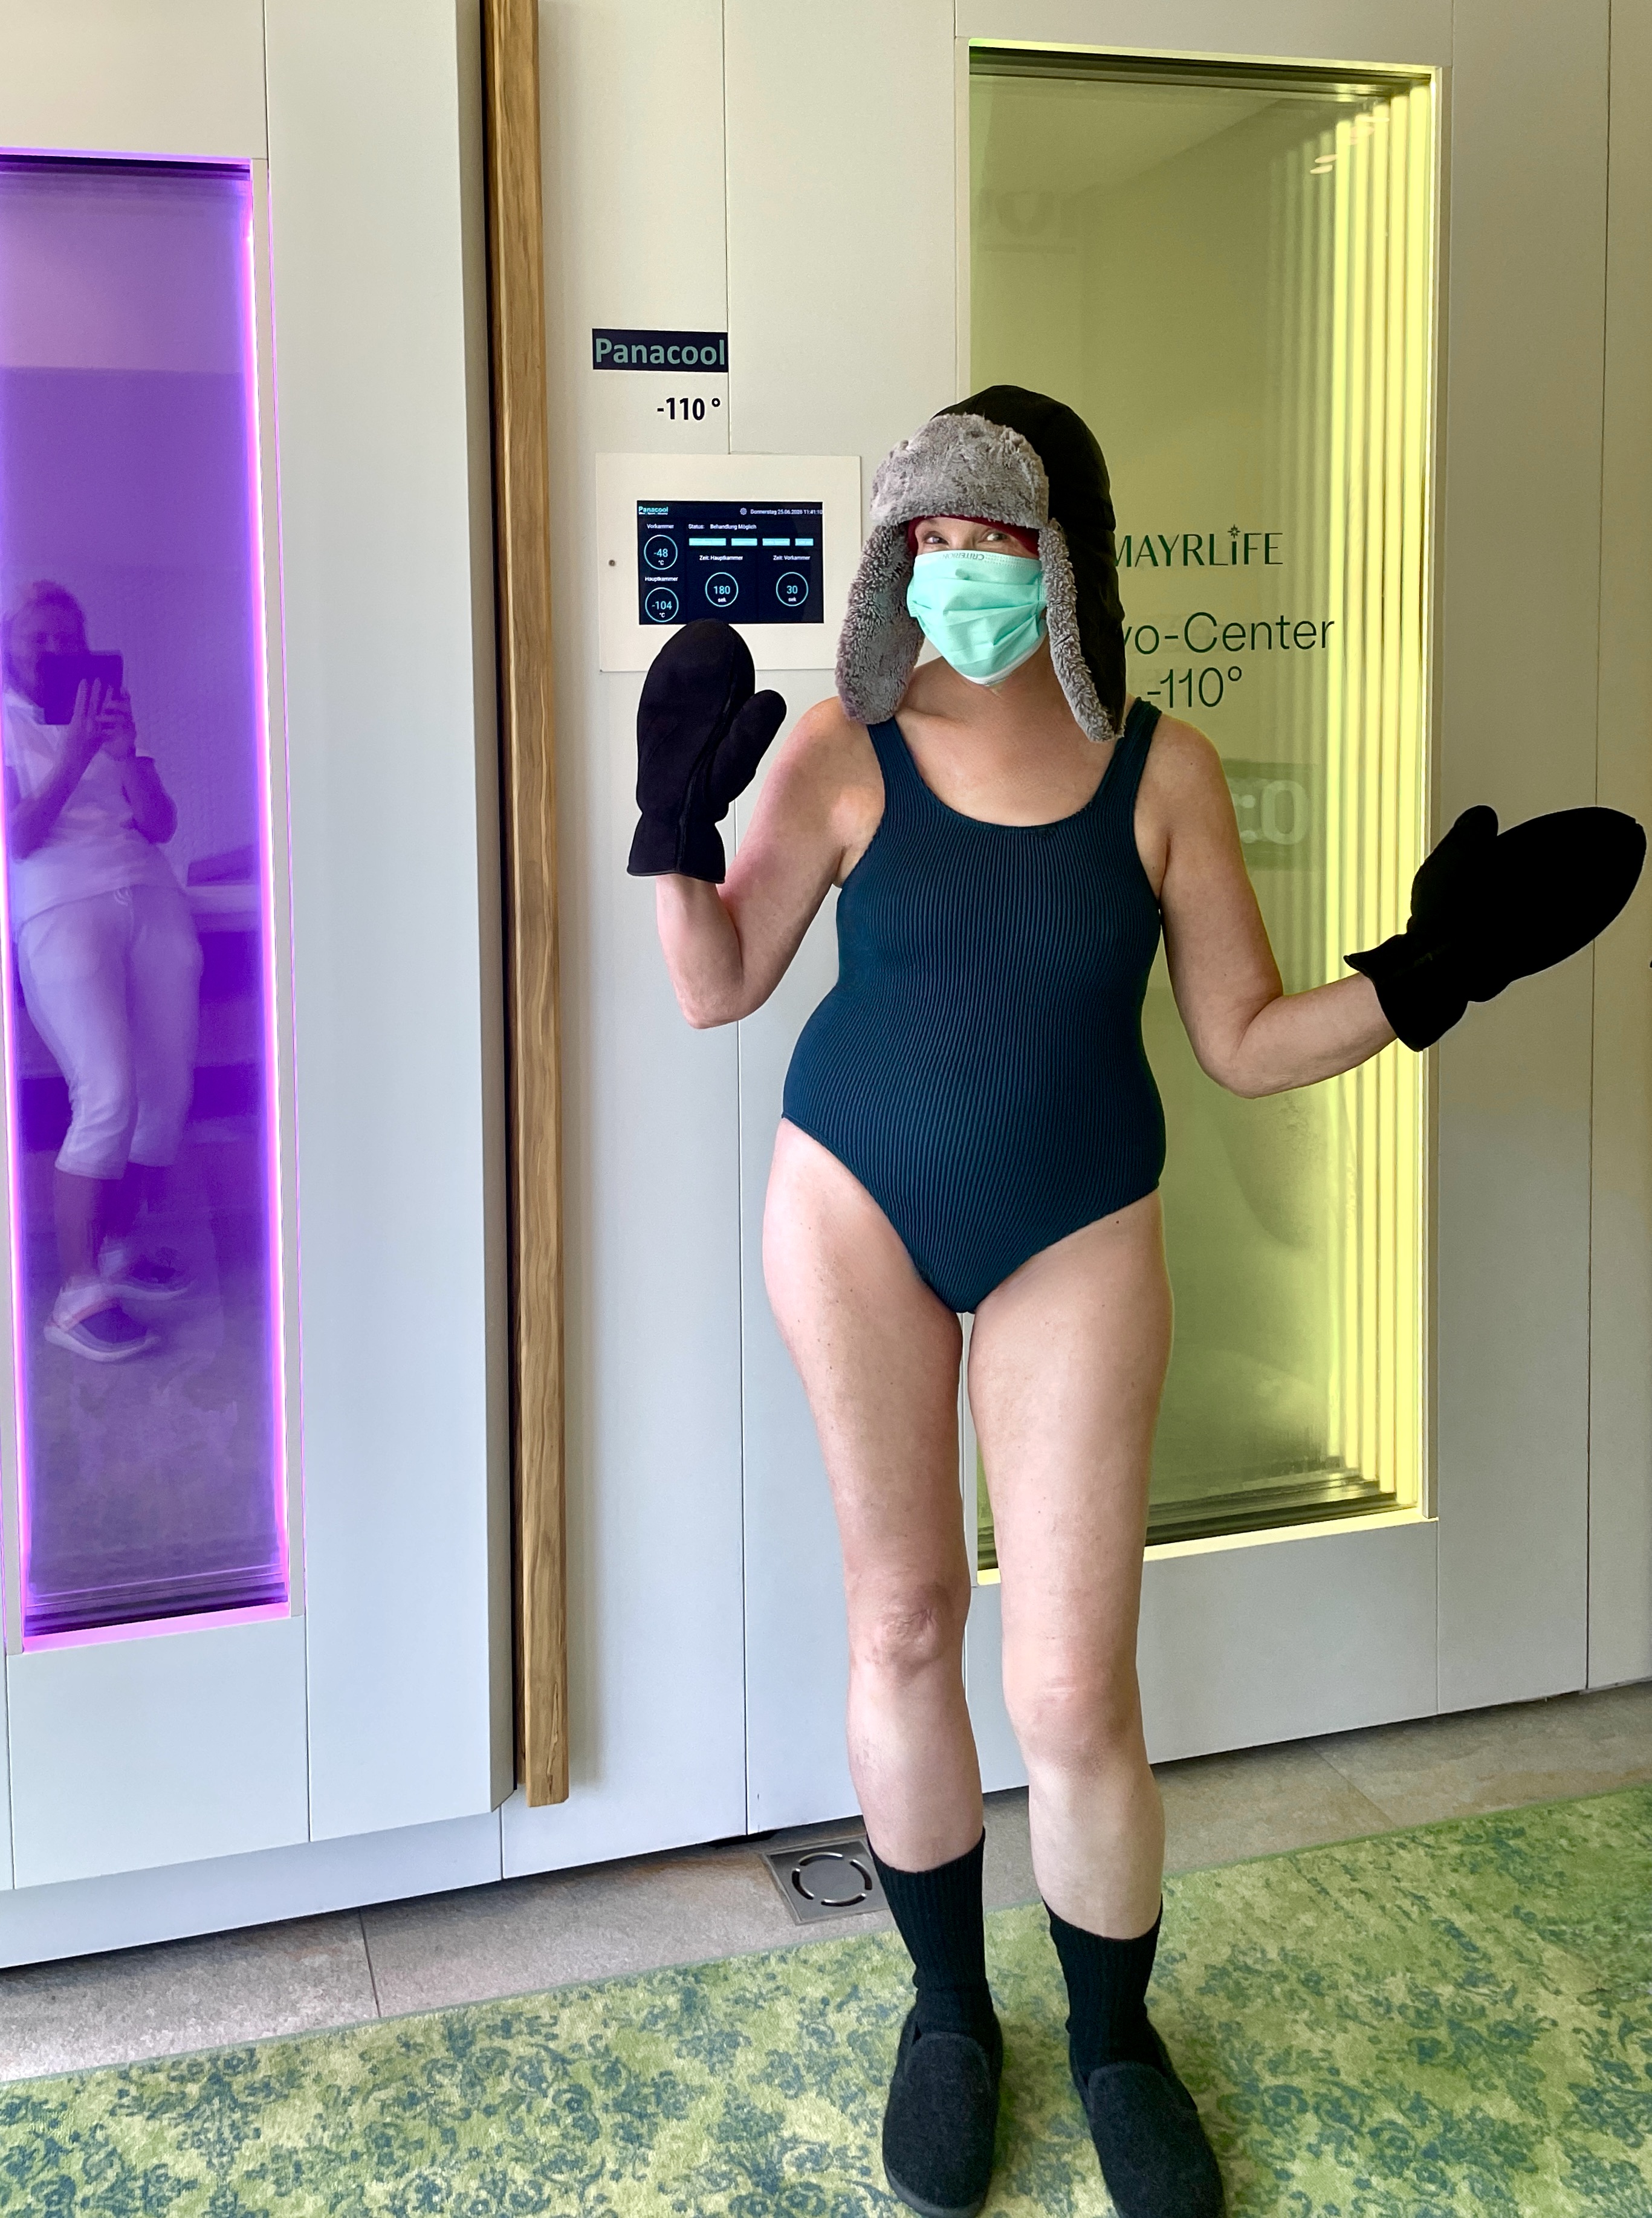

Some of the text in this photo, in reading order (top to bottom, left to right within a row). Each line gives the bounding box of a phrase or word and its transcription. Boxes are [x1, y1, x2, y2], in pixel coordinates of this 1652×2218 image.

[595, 338, 725, 365] Panacool
[653, 548, 668, 557] -48
[713, 585, 731, 594] 180
[786, 585, 798, 594] 30
[651, 601, 673, 610] -104
[1147, 666, 1242, 709] -110°
